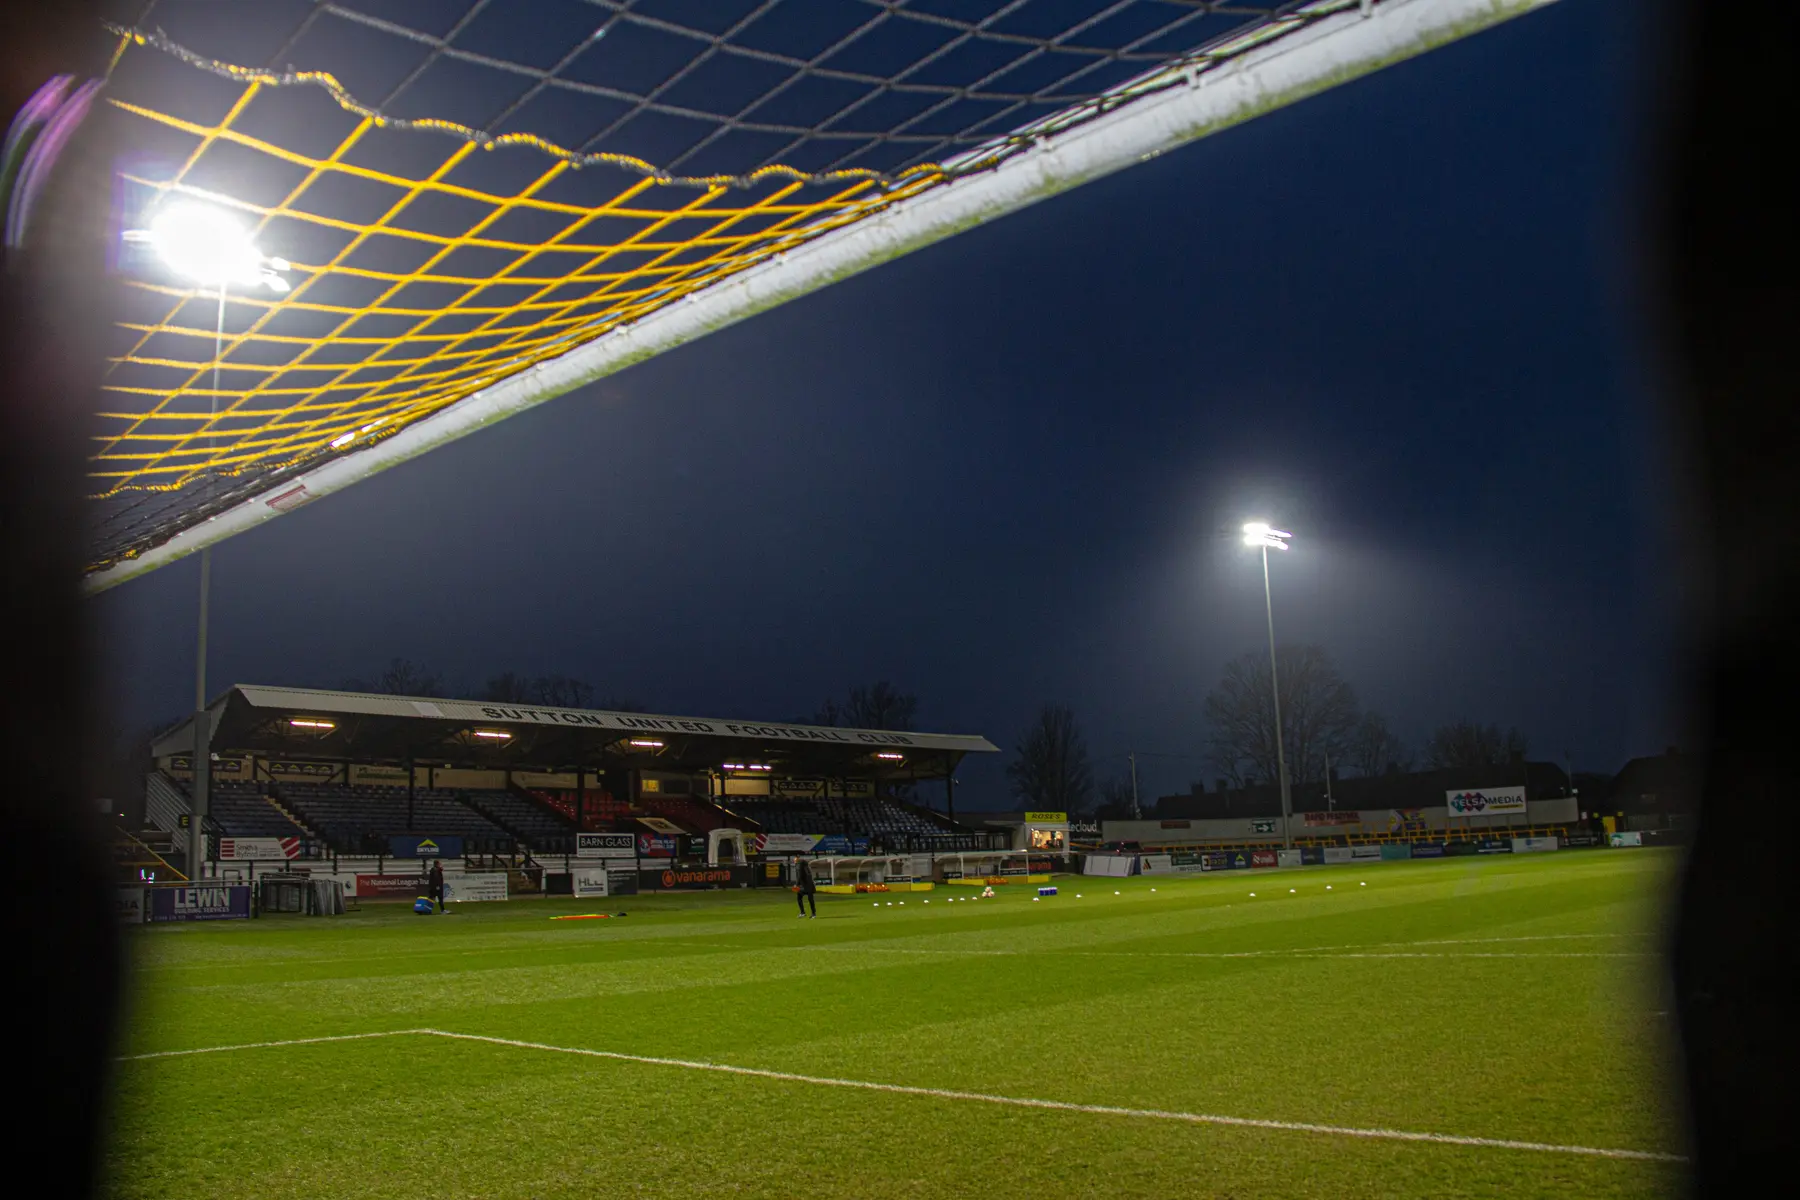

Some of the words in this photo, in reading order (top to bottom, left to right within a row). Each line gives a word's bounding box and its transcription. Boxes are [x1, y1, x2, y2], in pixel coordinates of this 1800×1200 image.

[482, 707, 603, 726] SUTTON
[616, 716, 714, 733] UNITED
[726, 724, 850, 741] FOOTBALL
[857, 733, 913, 745] CLUB
[1488, 795, 1524, 805] MEDIA
[1069, 820, 1097, 833] ecloud
[580, 837, 603, 847] BARN
[606, 837, 632, 847] GLASS
[675, 869, 731, 883] vanarama
[370, 879, 397, 887] National
[397, 879, 419, 888] League
[419, 878, 430, 886] Tru
[174, 887, 230, 908] LEWIN
